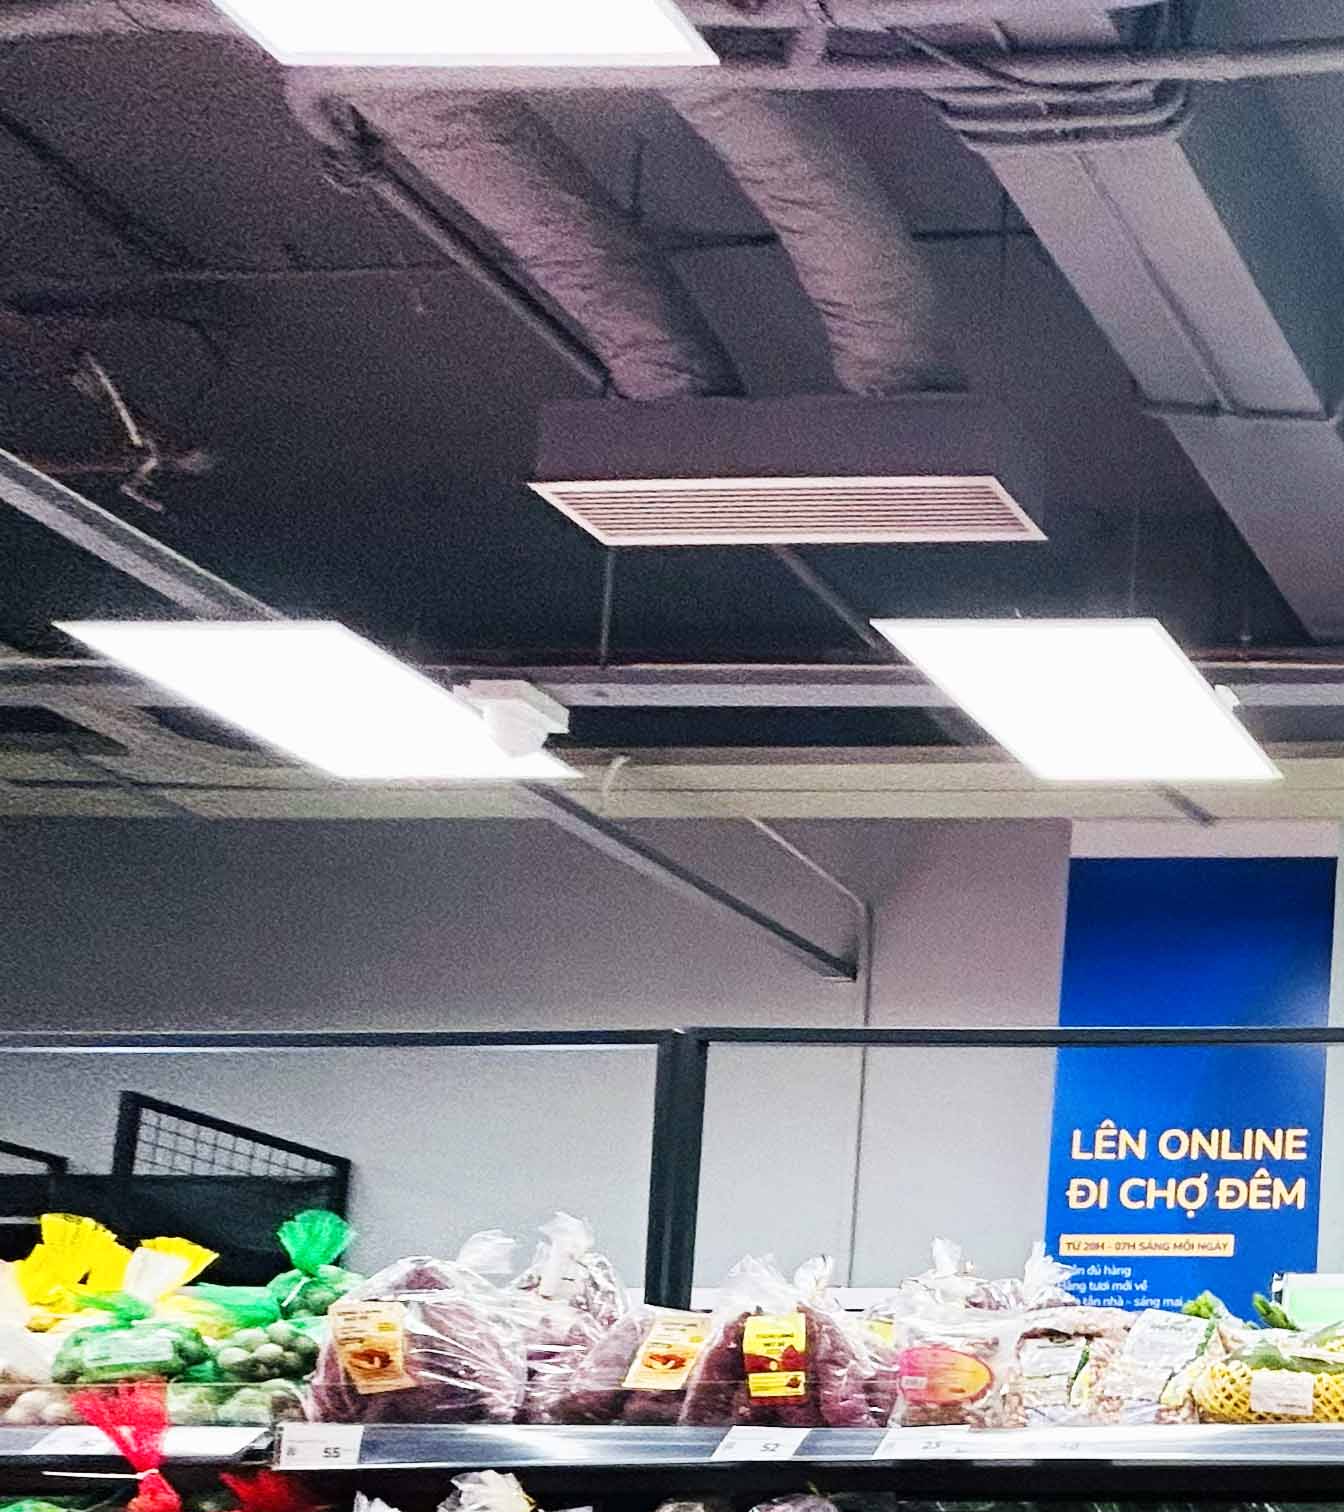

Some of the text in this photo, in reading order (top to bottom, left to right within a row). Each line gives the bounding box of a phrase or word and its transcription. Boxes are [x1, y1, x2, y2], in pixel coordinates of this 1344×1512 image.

[1071, 1119, 1309, 1161] LÊN ONLINE
[1065, 1167, 1307, 1219] ĐI CHỢ ĐÊM
[322, 1447, 341, 1458] 55
